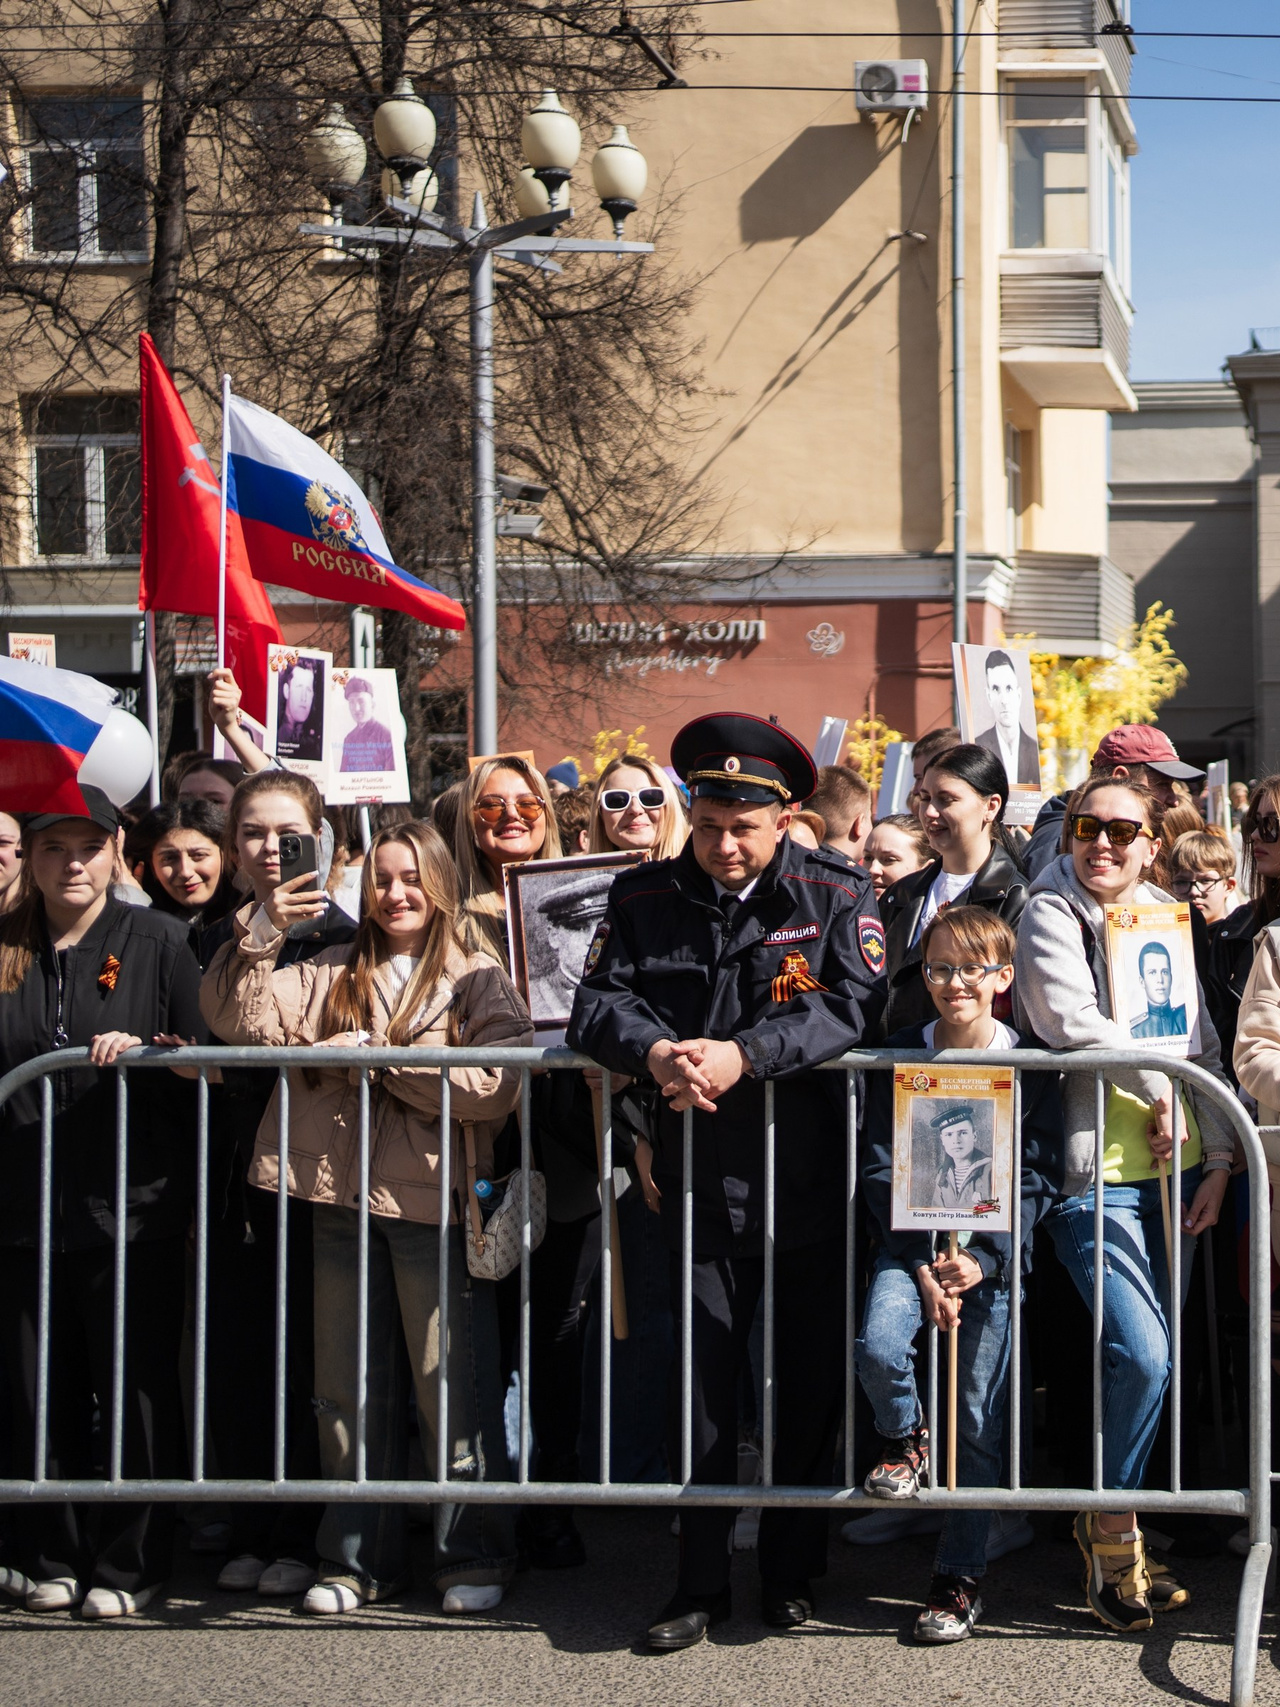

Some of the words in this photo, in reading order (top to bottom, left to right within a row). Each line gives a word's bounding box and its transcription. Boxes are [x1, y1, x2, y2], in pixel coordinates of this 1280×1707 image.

[292, 541, 388, 587] РОССИЯ
[766, 925, 817, 942] ПОЛИЦИЯ
[940, 1077, 991, 1085] БЕССМЕРТНЫЙ
[938, 1211, 955, 1219] Пётр
